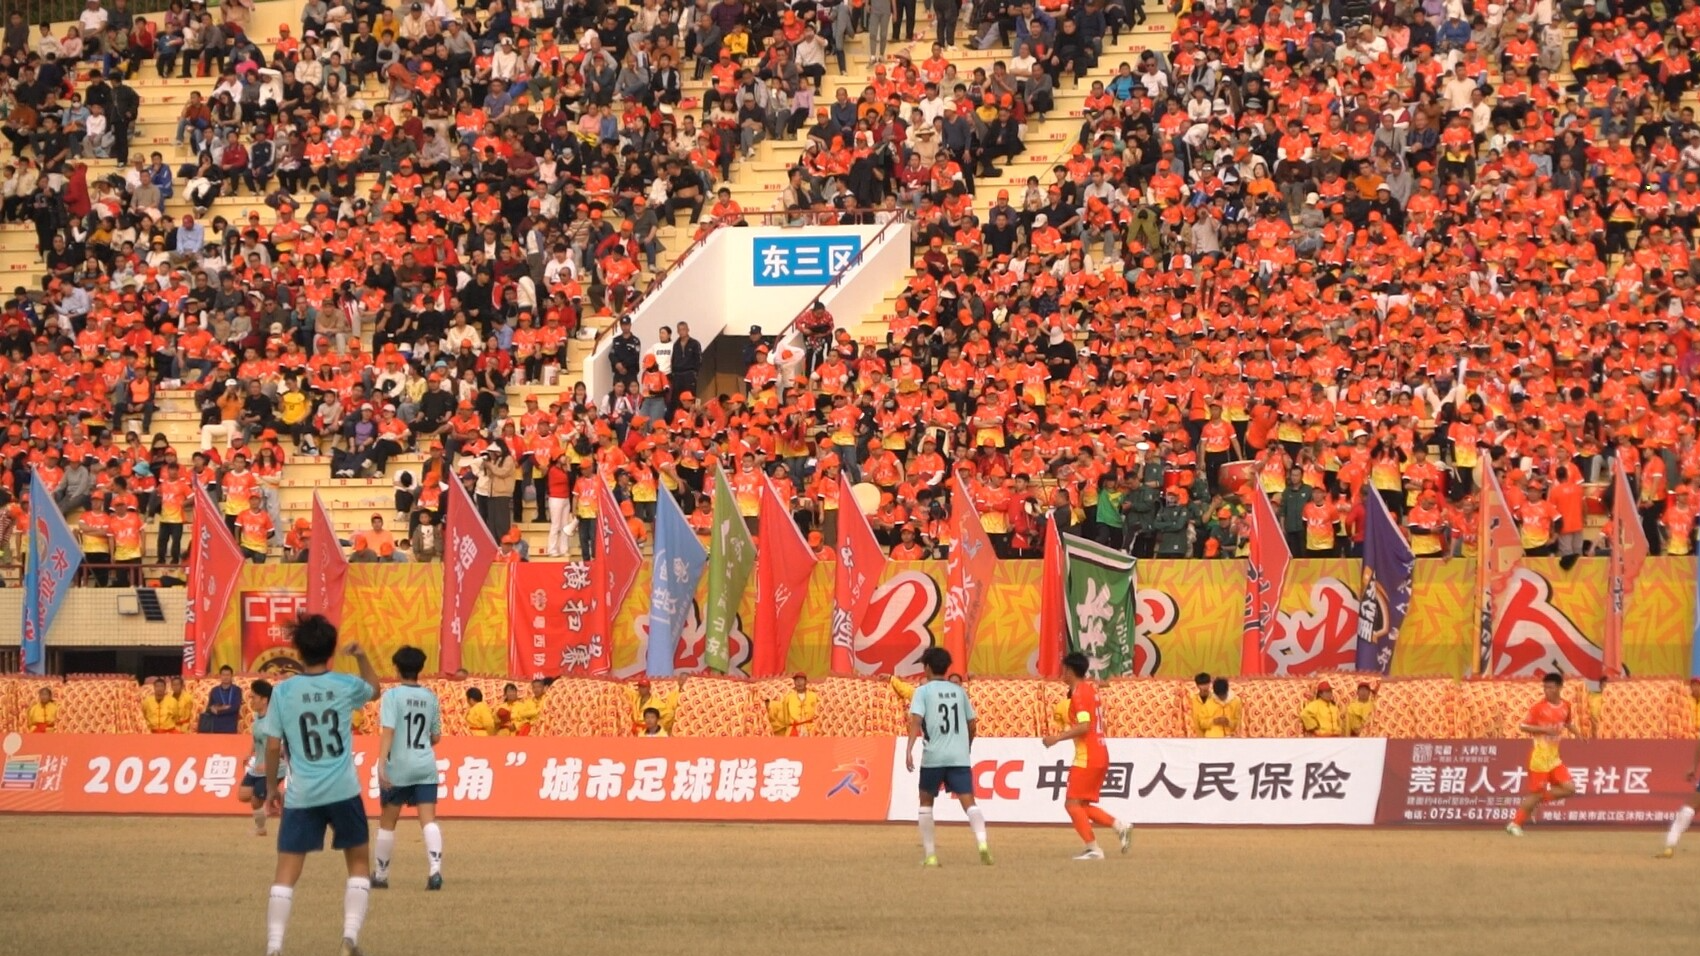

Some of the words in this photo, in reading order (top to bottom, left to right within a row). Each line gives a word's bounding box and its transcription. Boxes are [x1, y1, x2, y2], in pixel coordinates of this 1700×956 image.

[762, 244, 855, 279] 东三区
[298, 708, 345, 762] 63
[403, 711, 426, 750] 12
[938, 702, 960, 735] 31
[1036, 760, 1350, 801] 中国人民保险
[1408, 765, 1652, 795] 莞韶人才居社区
